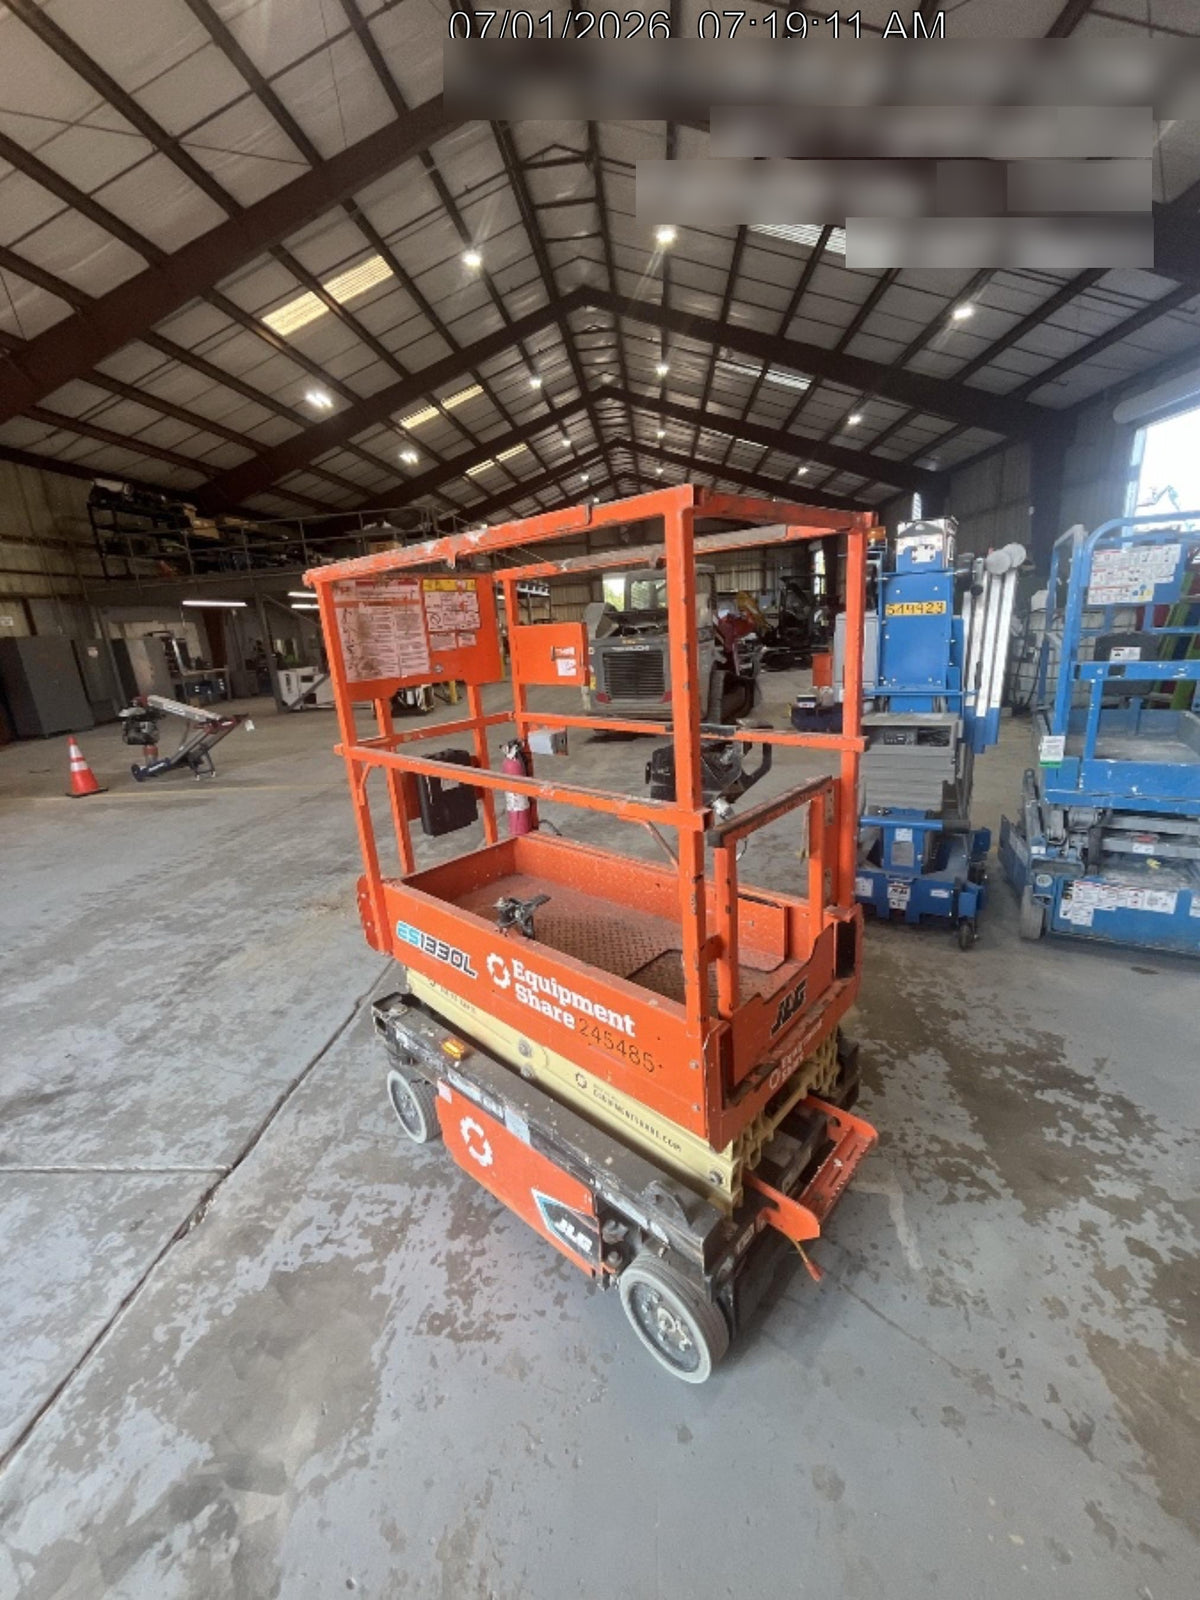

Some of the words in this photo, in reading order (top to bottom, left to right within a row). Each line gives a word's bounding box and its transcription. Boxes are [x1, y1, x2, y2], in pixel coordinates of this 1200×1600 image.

[397, 920, 477, 980] ES1330L
[511, 958, 636, 1037] Equipment
[515, 983, 576, 1030] Share
[578, 1018, 655, 1074] 245485
[554, 1218, 593, 1254] JLG
